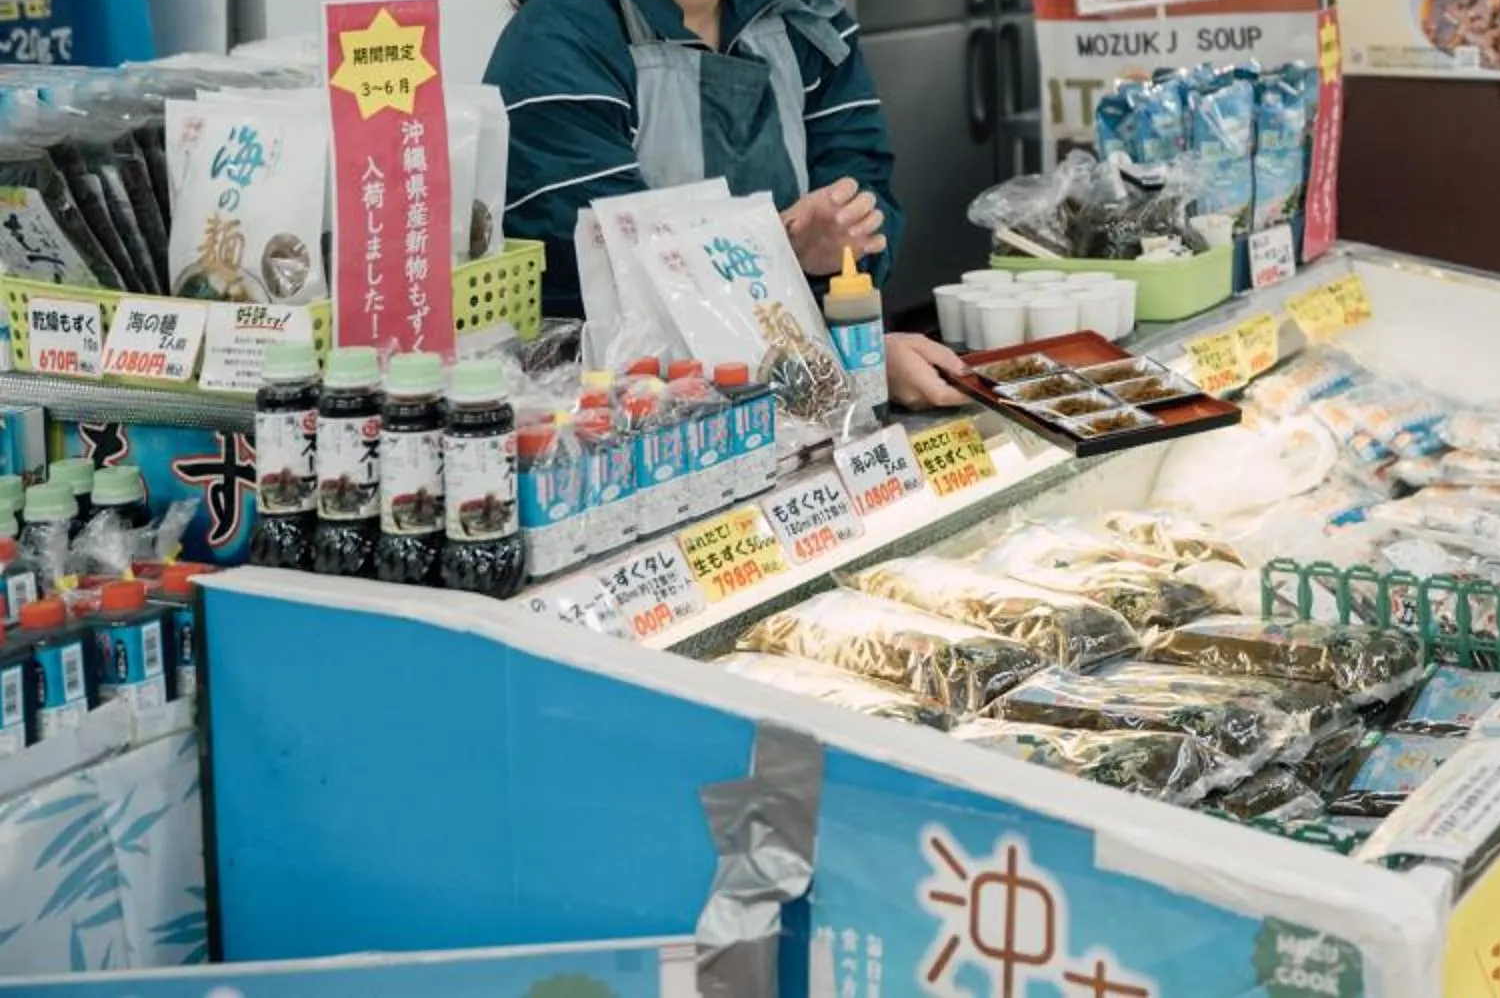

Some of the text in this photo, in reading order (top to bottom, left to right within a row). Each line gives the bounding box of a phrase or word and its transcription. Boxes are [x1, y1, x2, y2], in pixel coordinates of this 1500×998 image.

[1197, 26, 1263, 52] SOUP
[352, 43, 415, 65] 期間限定
[401, 119, 431, 353] 沖縄県産新物もずく
[32, 310, 96, 335] 乾燥もずく
[125, 311, 177, 337] 海の麺
[39, 350, 79, 371] 670円
